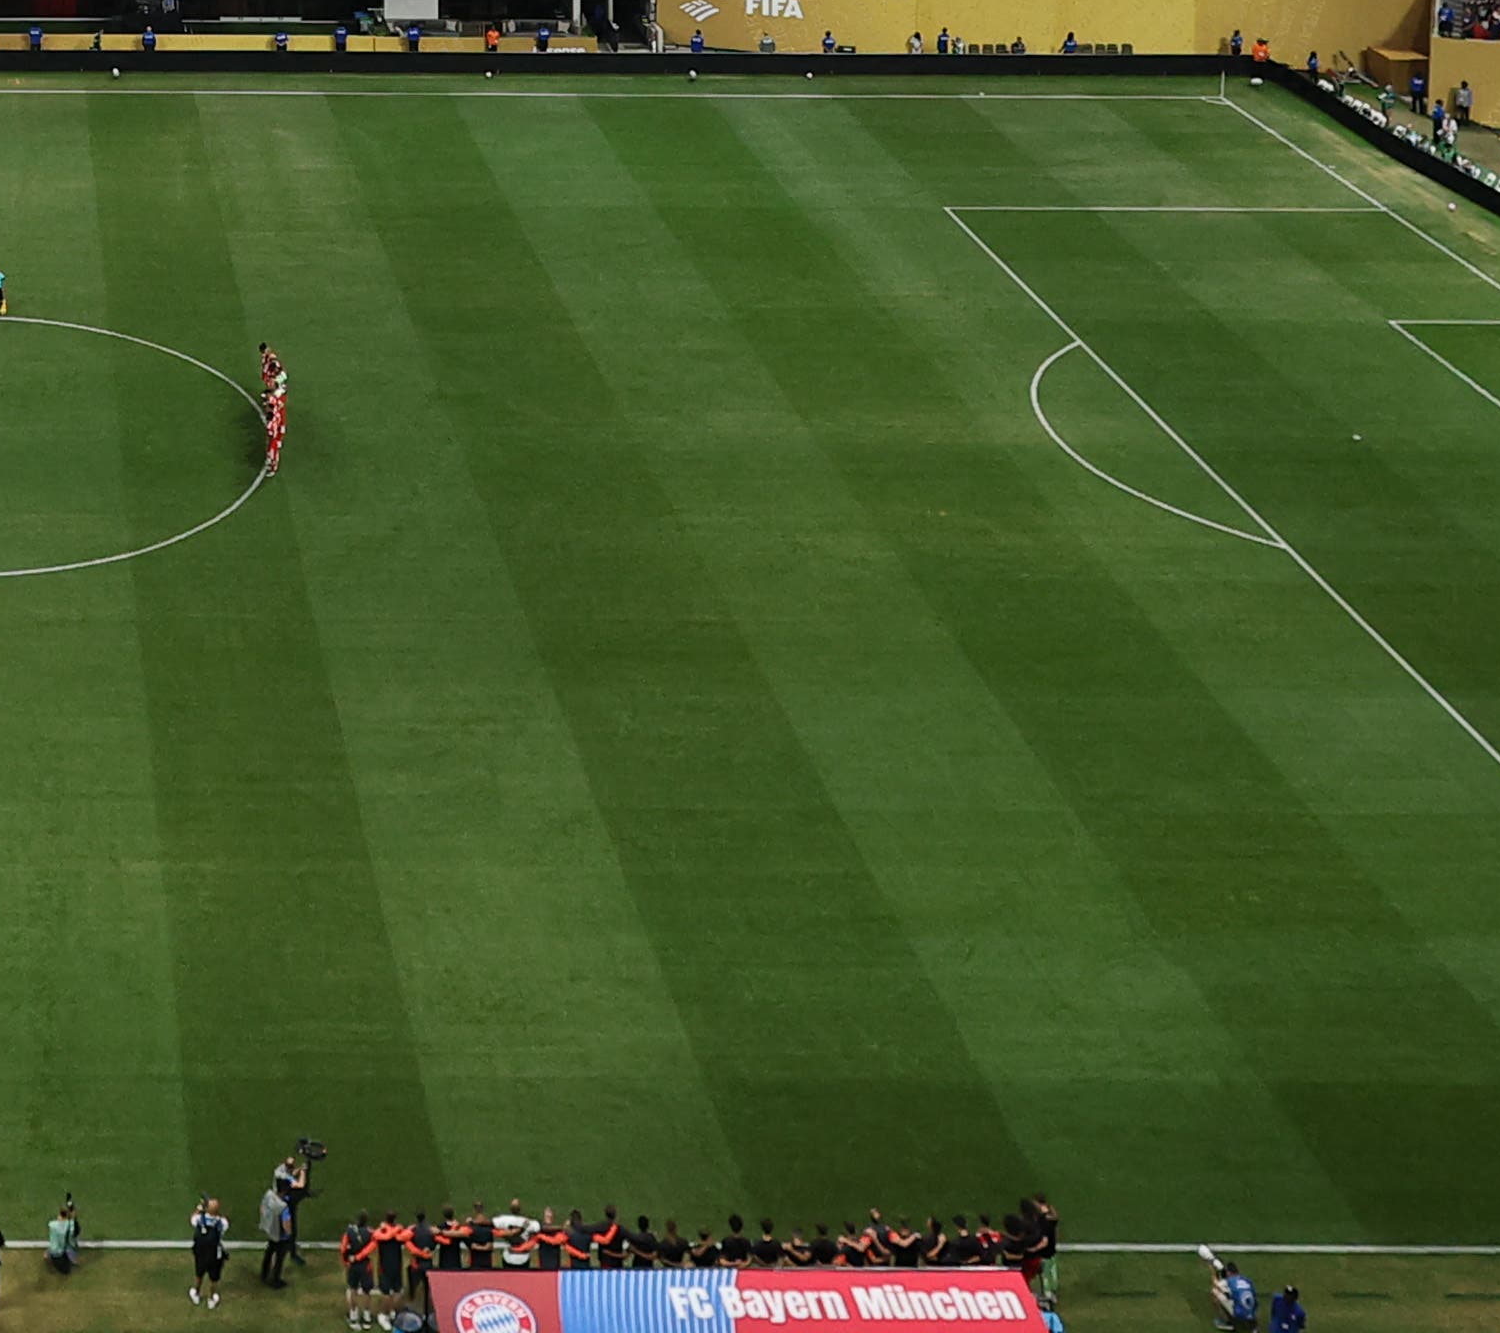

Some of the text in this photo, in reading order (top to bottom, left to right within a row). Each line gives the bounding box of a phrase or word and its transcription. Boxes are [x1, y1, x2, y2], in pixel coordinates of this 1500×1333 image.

[458, 1291, 533, 1321] FC BAYERN
[668, 1284, 1026, 1323] FC Bayern München
